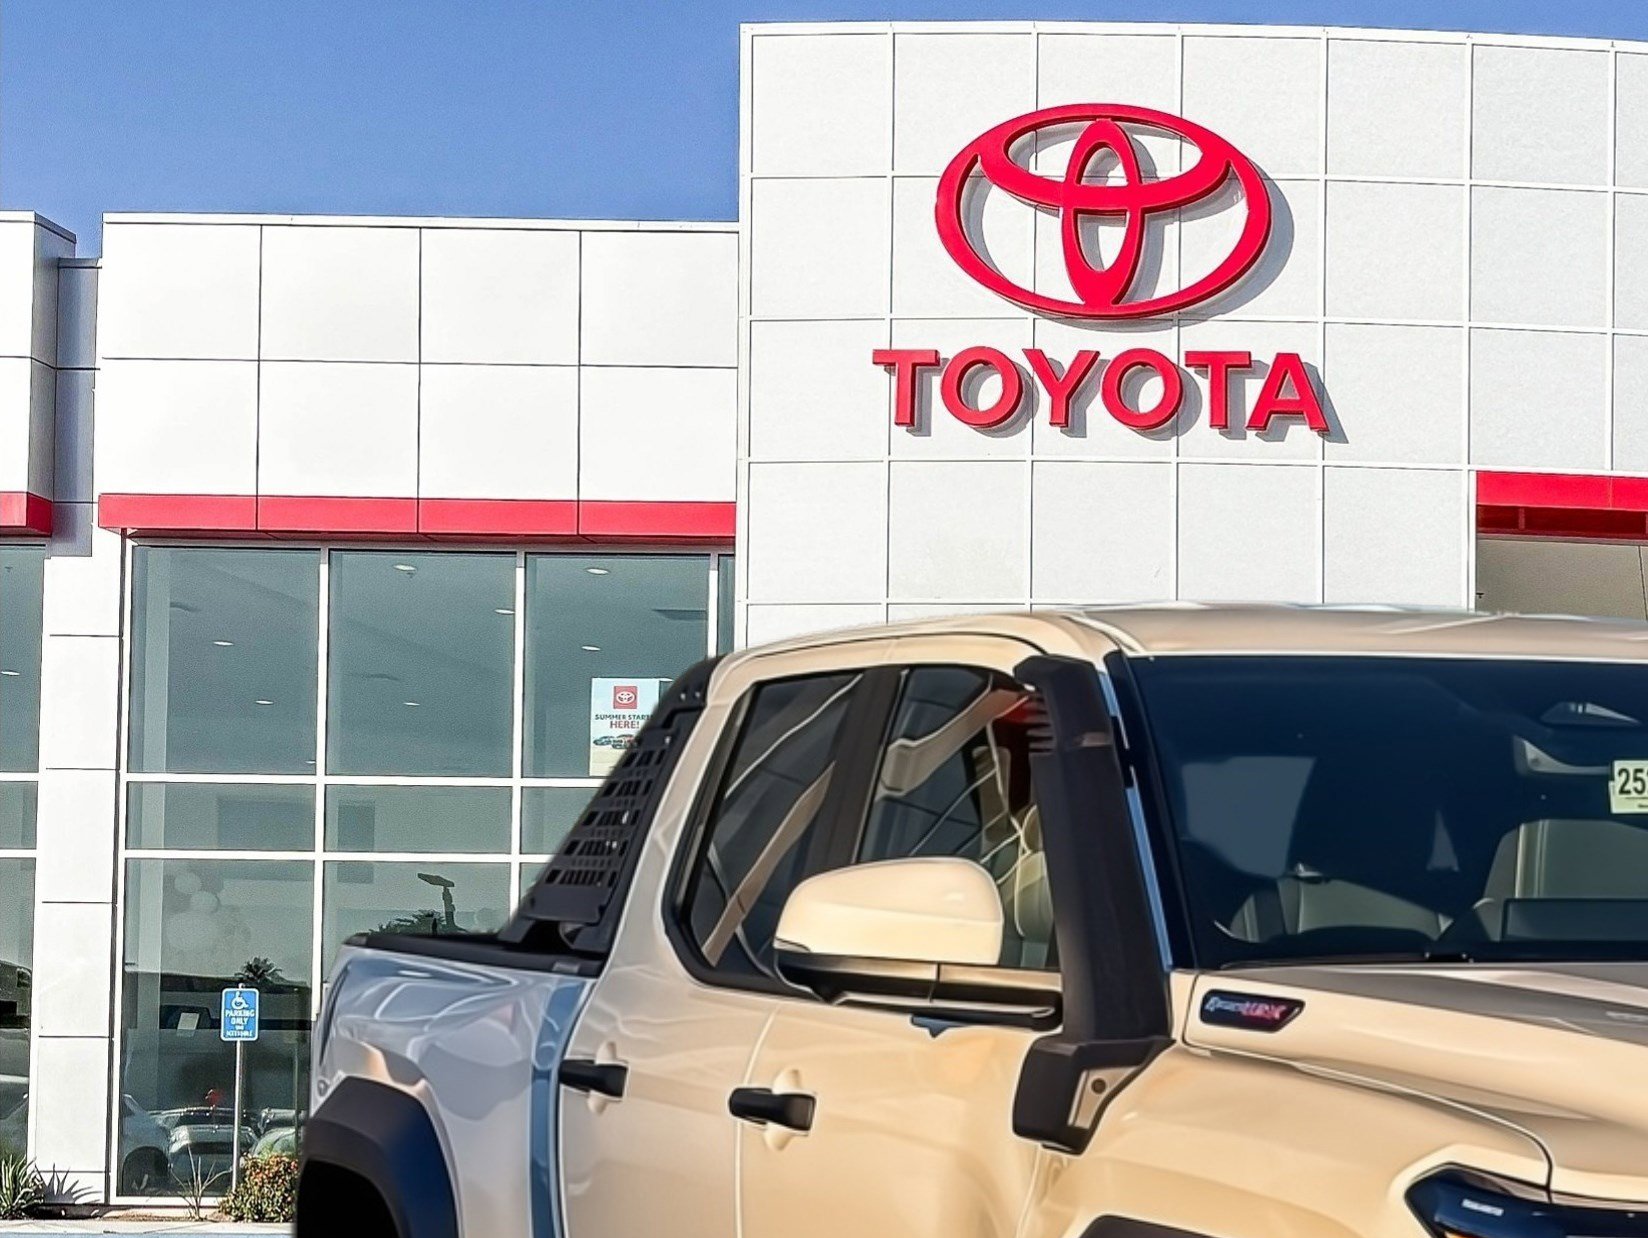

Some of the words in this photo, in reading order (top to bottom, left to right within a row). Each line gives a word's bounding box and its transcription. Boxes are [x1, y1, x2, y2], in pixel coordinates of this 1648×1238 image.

[872, 345, 1330, 432] TOYOTA
[610, 720, 640, 729] HERE!
[225, 1009, 255, 1017] PARKING
[231, 1017, 248, 1025] ONLY
